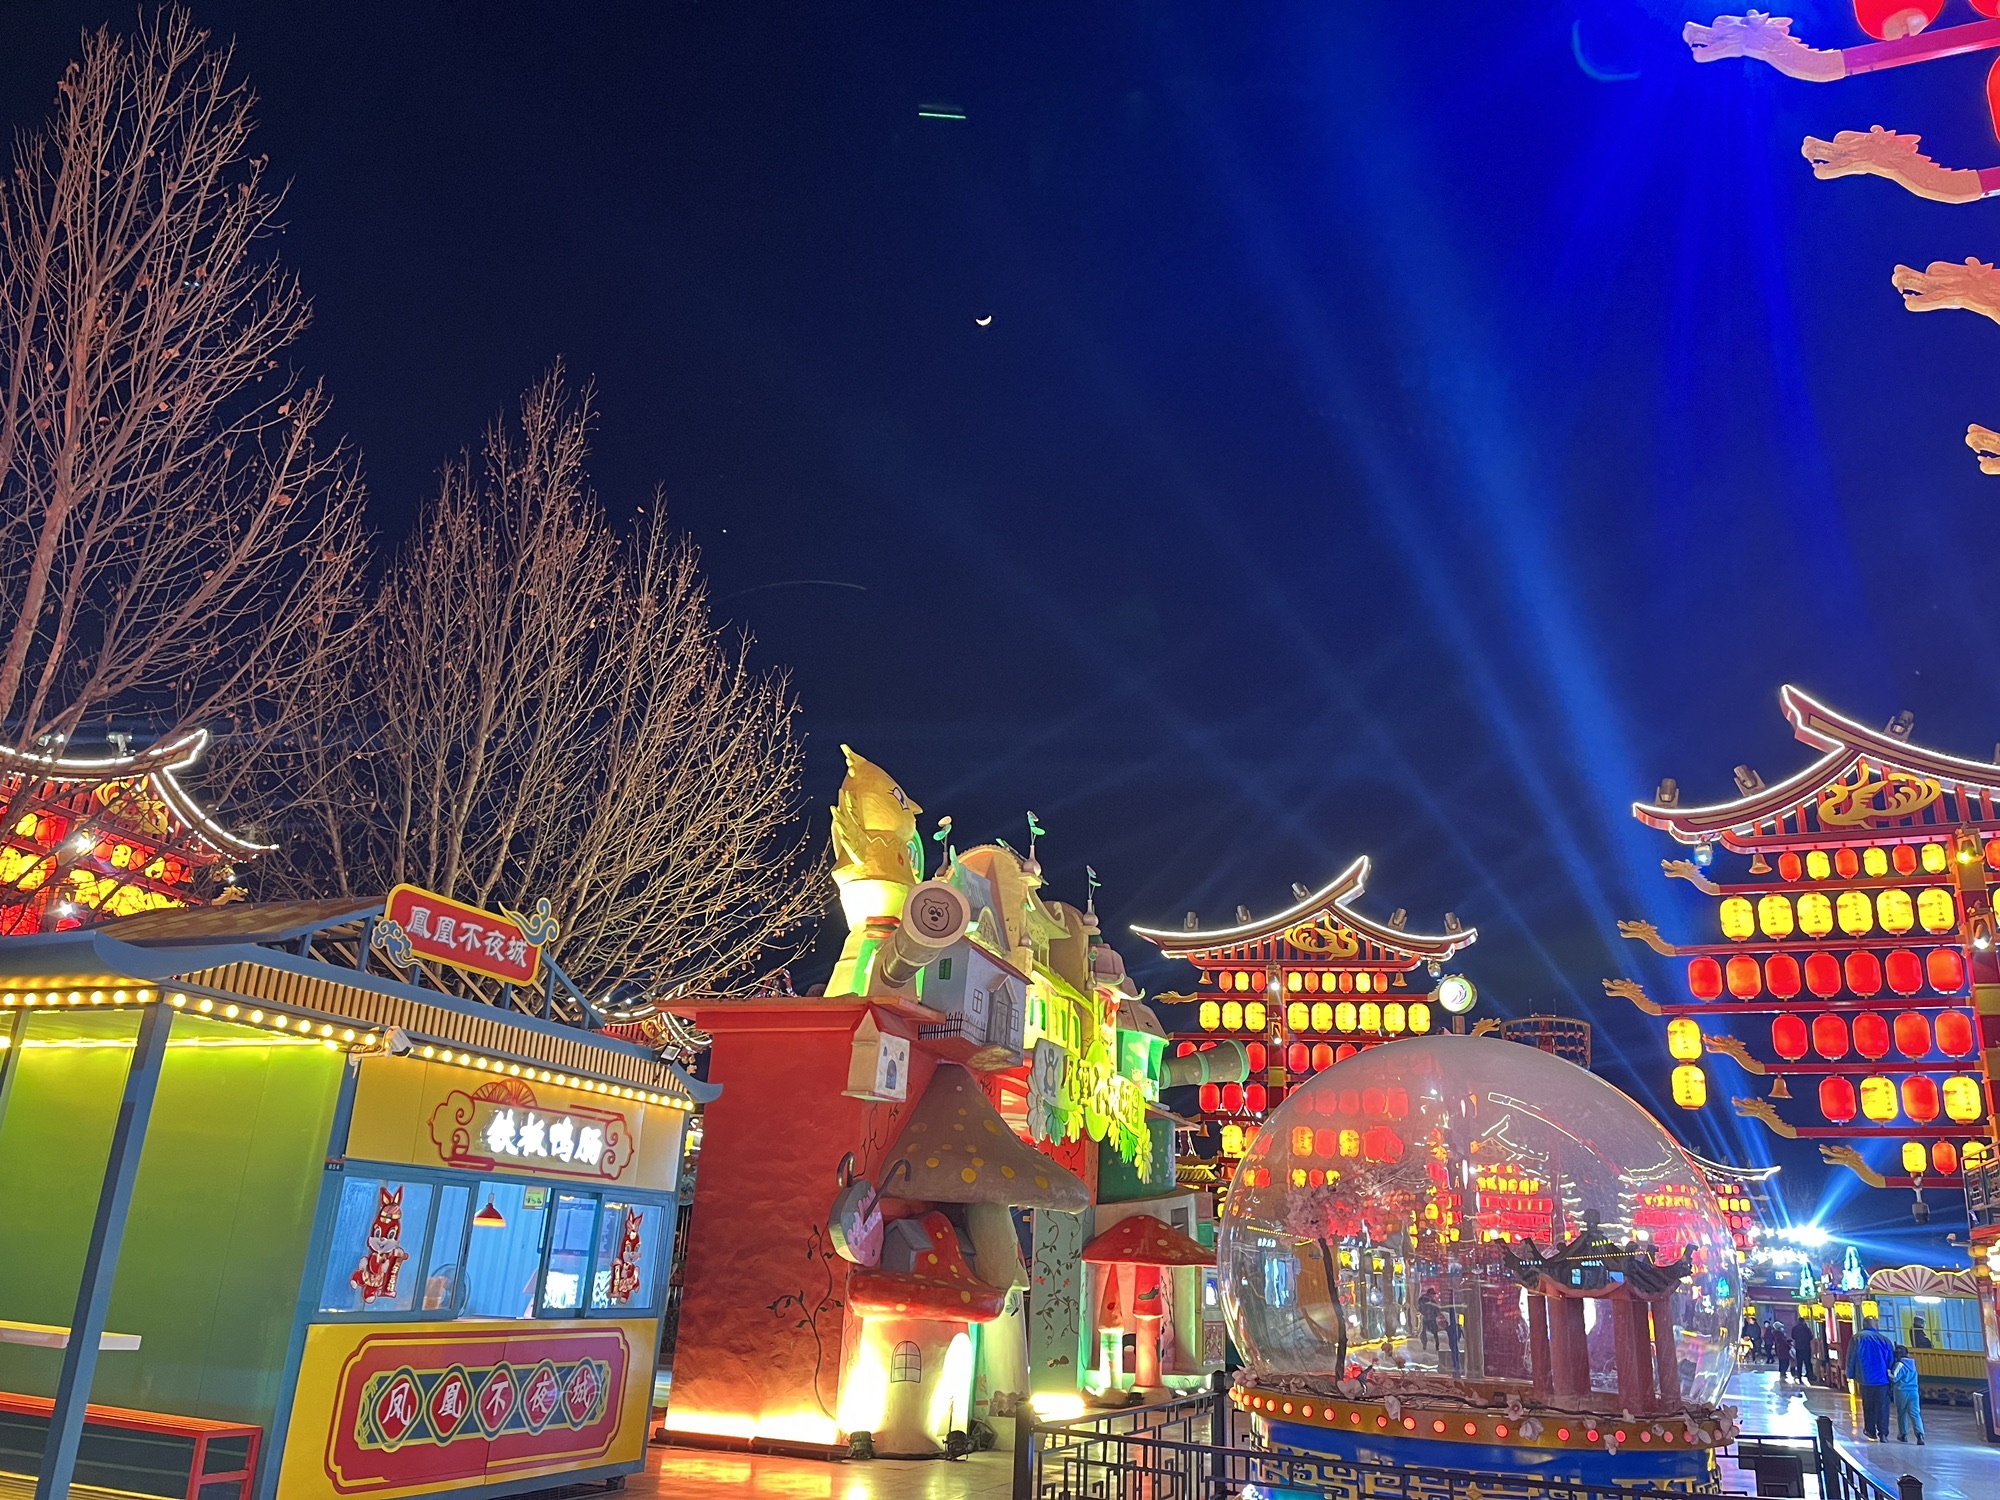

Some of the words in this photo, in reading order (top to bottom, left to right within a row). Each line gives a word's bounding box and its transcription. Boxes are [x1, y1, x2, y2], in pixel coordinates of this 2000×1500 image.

[406, 905, 529, 968] 鳳凰不夜城
[382, 1369, 591, 1426] 凤凰不夜城
